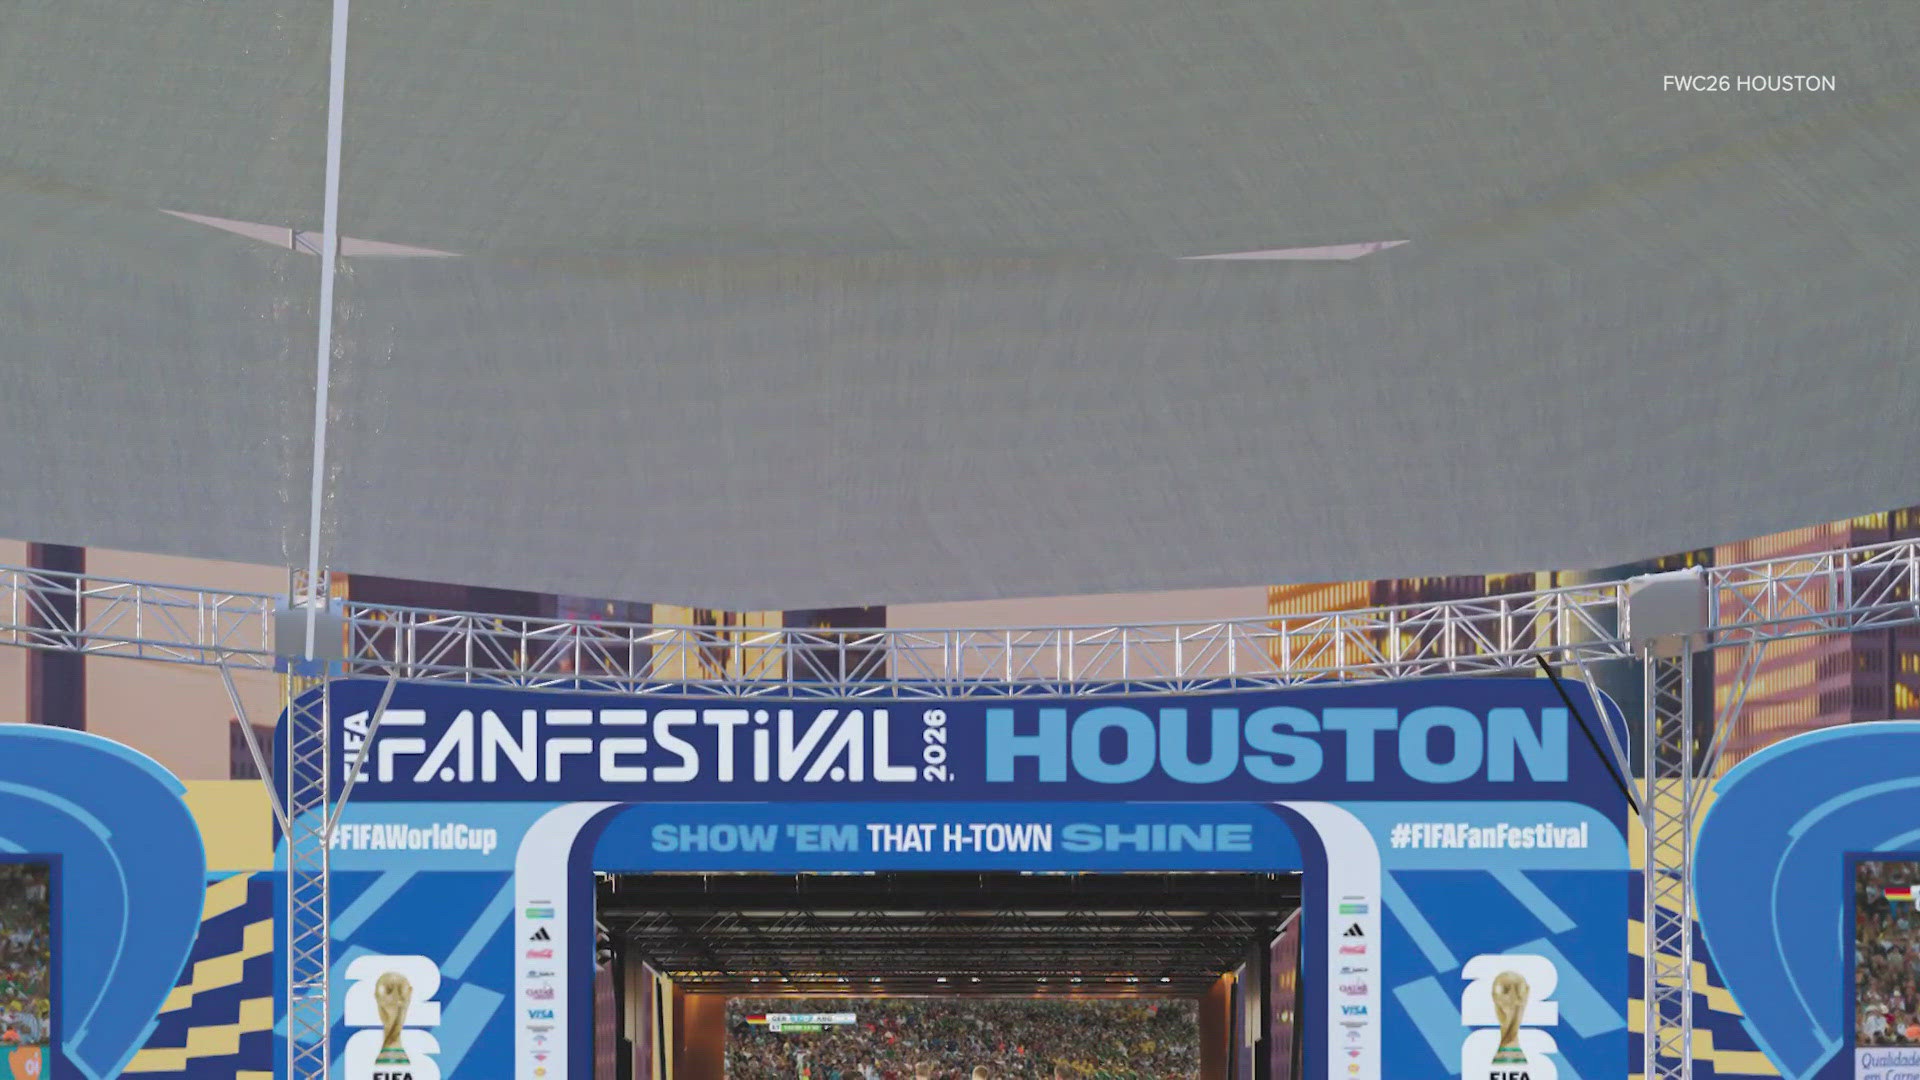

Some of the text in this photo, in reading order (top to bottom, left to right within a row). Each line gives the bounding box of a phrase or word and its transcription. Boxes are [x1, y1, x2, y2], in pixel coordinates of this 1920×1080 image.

[343, 710, 369, 783] FIFA
[922, 709, 947, 782] 2026
[986, 706, 1569, 784] HOUSTON
[651, 823, 779, 852] SHOW
[867, 823, 936, 852] THAT
[943, 823, 1052, 852] H-TOWN
[1061, 823, 1253, 852] SHINE
[1390, 821, 1588, 849] #FIFAFanFestival
[528, 1009, 554, 1019] VISA
[1341, 1005, 1368, 1015] VISA
